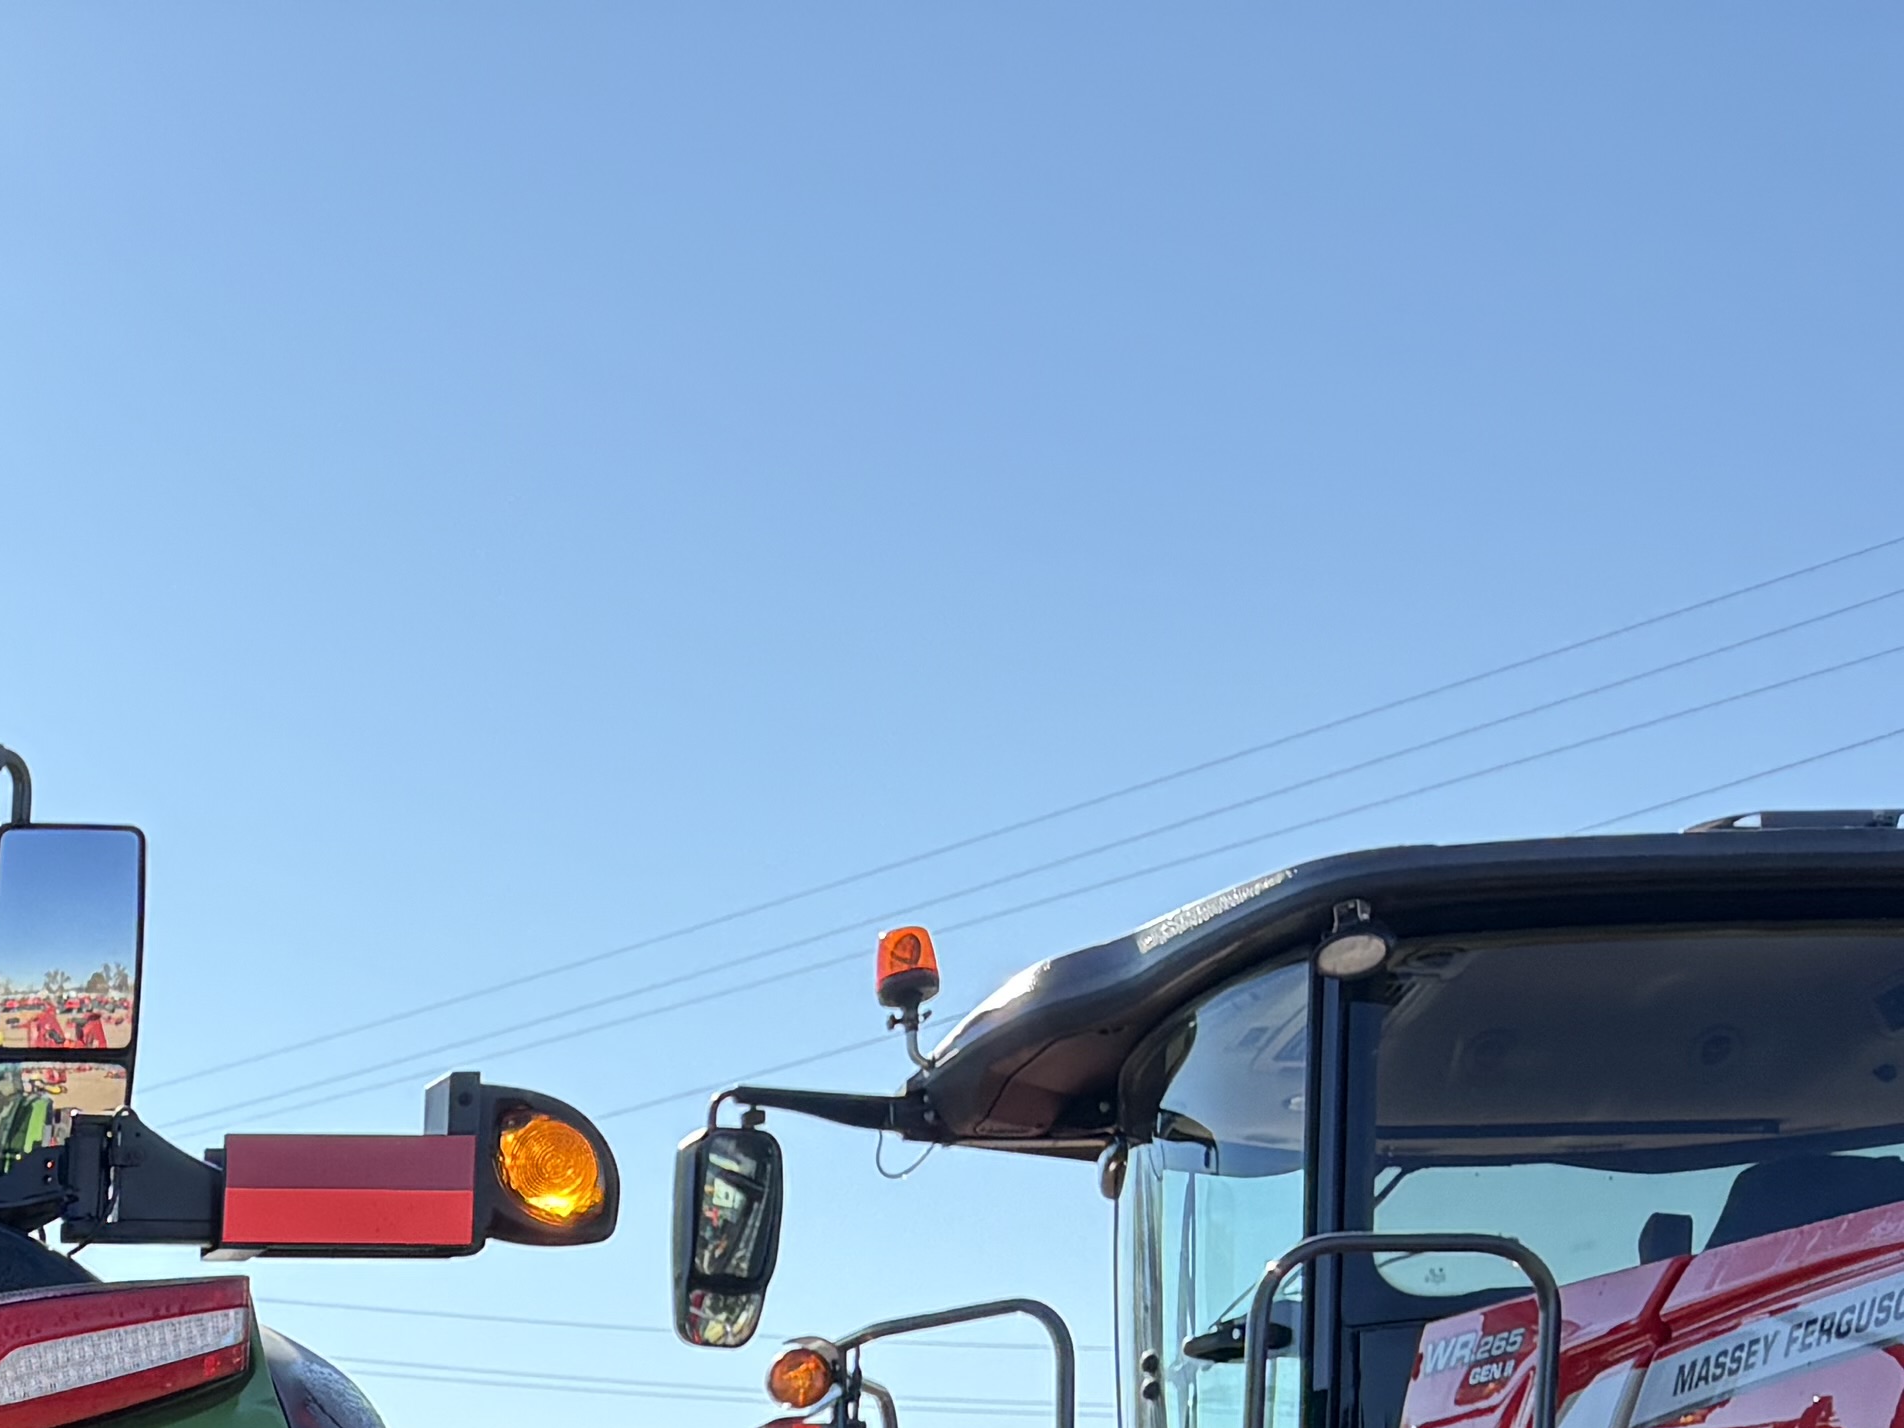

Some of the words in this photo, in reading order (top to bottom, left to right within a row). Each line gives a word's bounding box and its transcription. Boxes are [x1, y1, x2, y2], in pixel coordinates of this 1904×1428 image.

[1468, 1361, 1504, 1386] GEN
[1503, 1359, 1516, 1378] II
[1672, 1329, 1781, 1397] MASSEY
